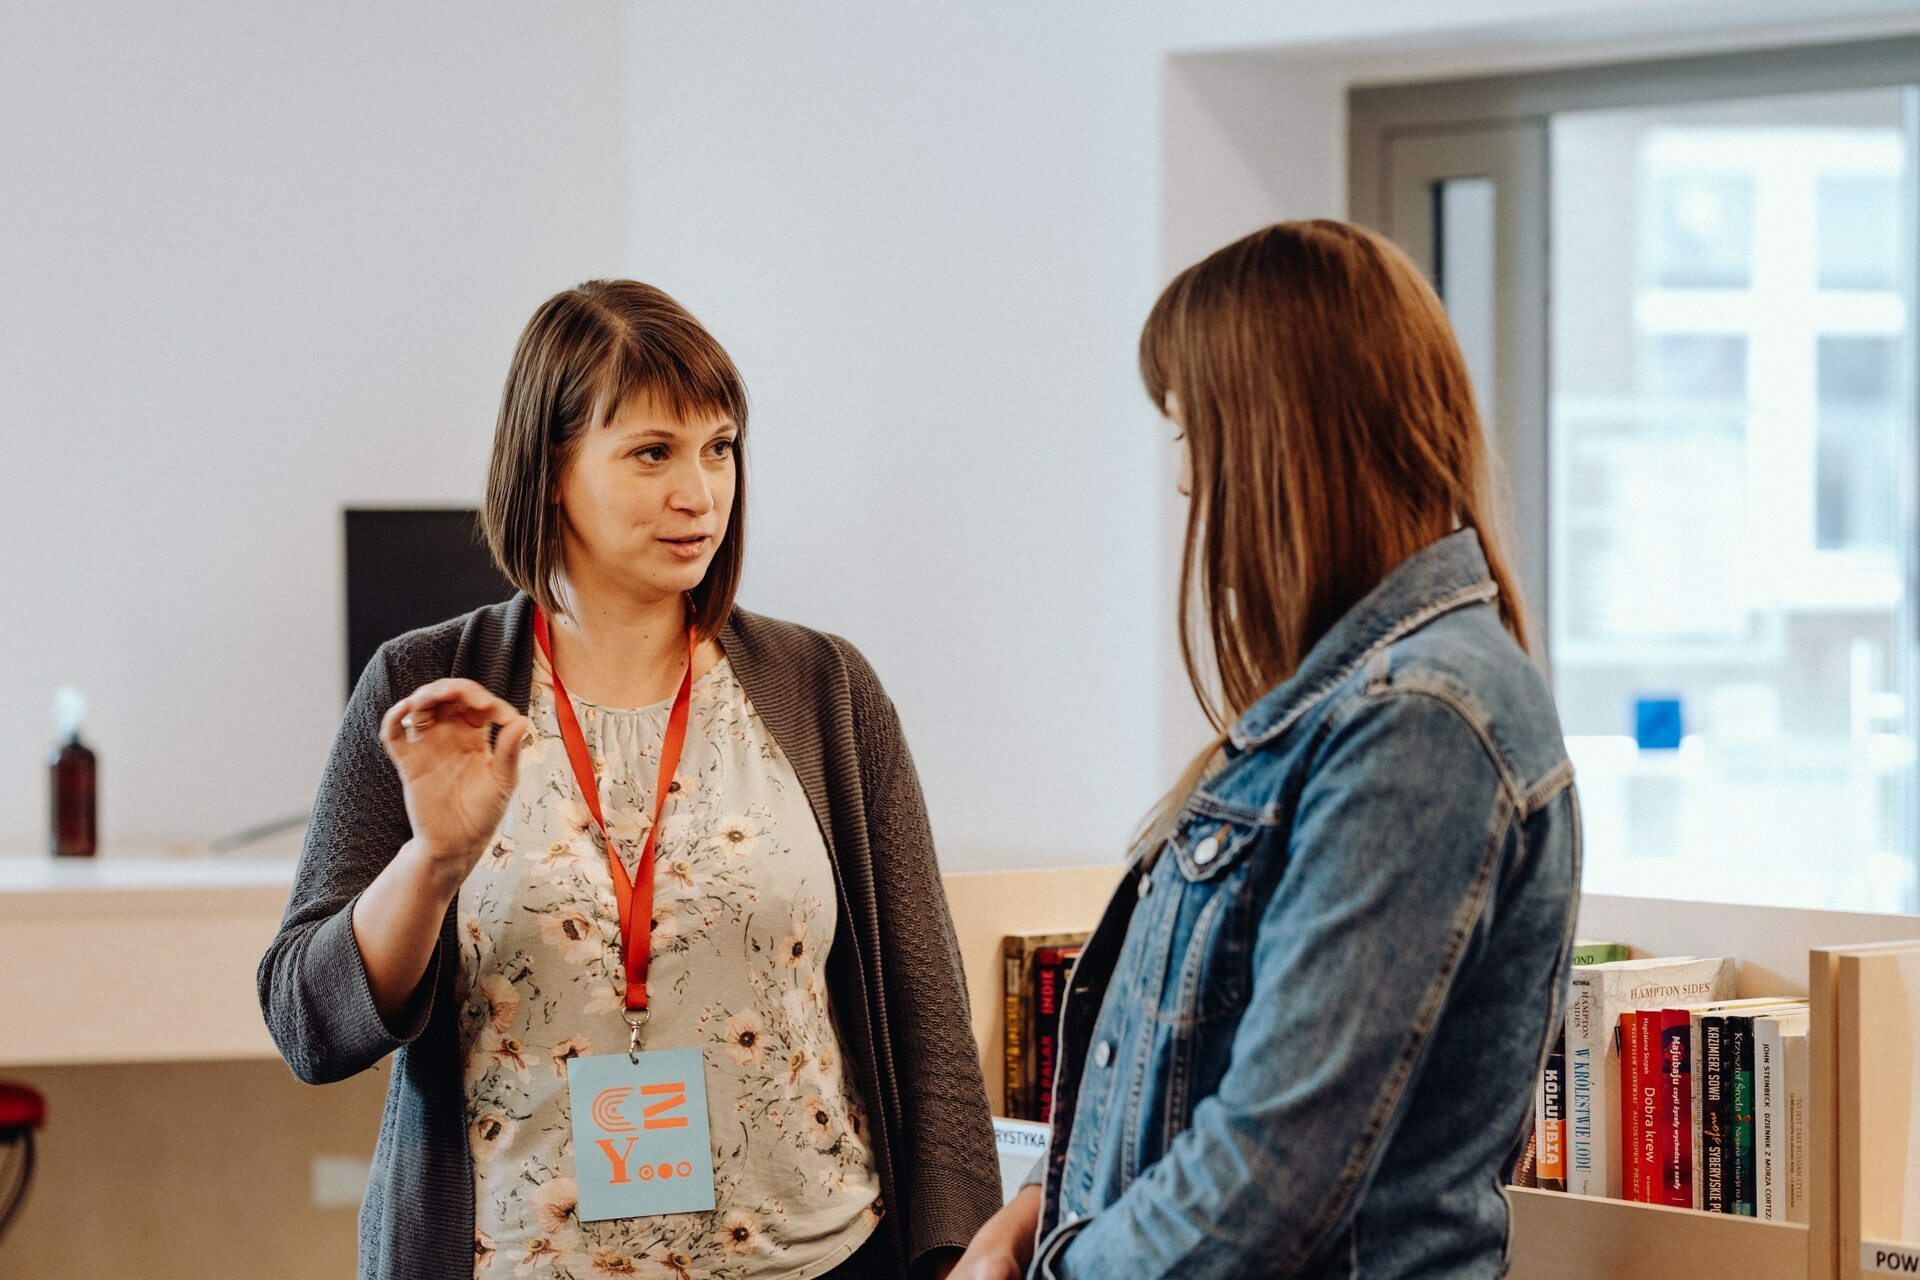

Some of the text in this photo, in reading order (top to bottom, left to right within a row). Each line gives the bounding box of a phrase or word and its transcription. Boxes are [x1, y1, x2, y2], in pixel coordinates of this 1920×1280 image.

[1630, 983, 1710, 1000] HAMPTON SIDES
[1575, 1048, 1590, 1058] W
[1670, 1036, 1682, 1084] Majubaju
[1708, 1027, 1720, 1100] KAZIMIERZ SOWA
[1733, 1033, 1745, 1112] Krzysztof Środa
[1762, 1044, 1770, 1063] JOHN
[1545, 1069, 1558, 1164] KOLUMBIA
[1574, 1062, 1595, 1137] KRÓLESTWIE
[1645, 1088, 1656, 1127] Dobra
[1645, 1131, 1656, 1163] krew
[1704, 1112, 1721, 1144] moje
[1575, 1141, 1591, 1173] LODU
[1709, 1147, 1721, 1201] SYBERYJSKIE
